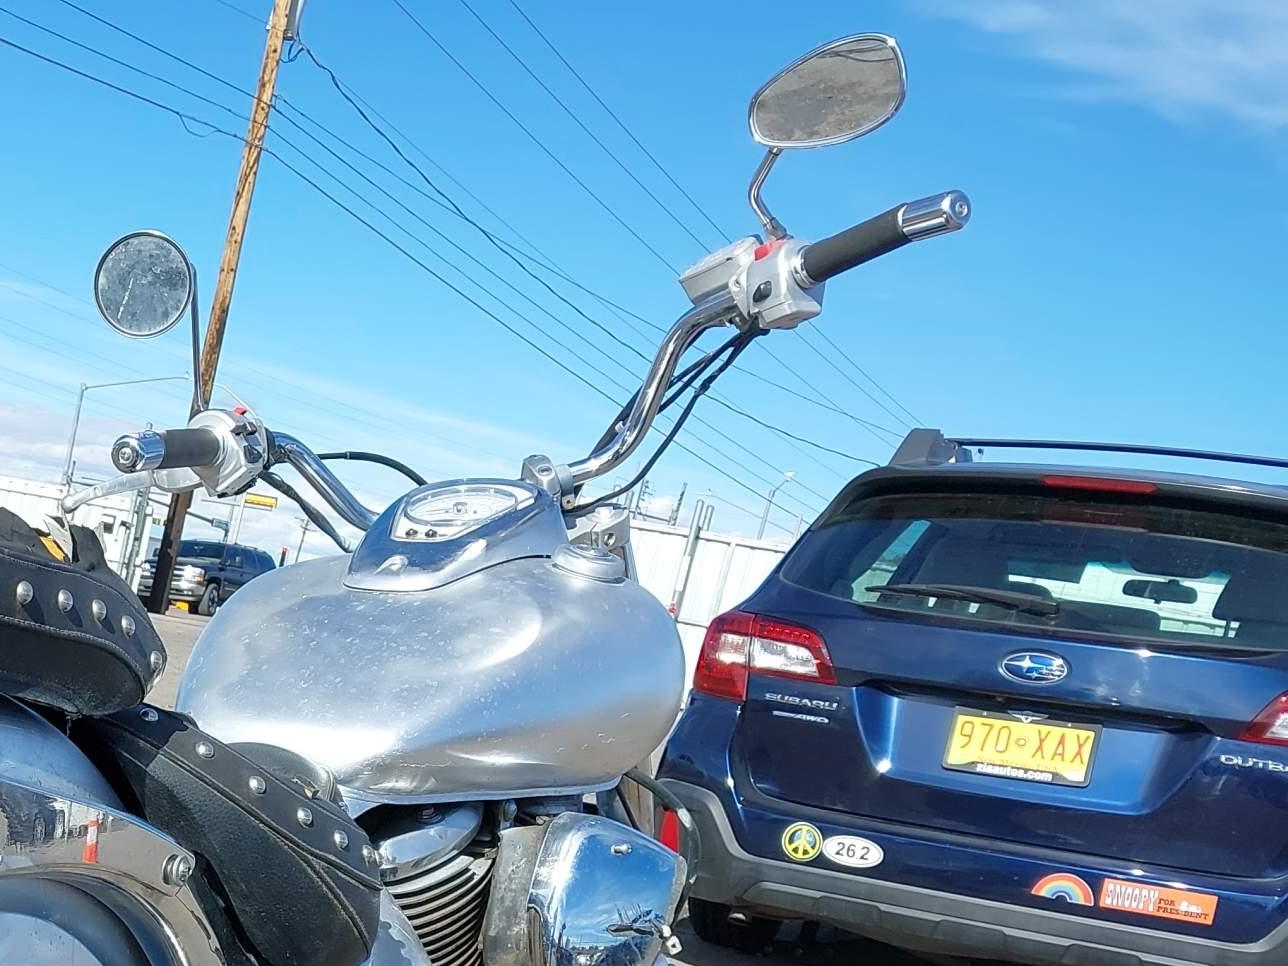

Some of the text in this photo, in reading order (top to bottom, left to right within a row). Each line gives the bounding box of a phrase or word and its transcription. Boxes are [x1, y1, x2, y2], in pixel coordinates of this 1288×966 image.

[764, 692, 838, 710] SUBARU
[959, 720, 1012, 754] 970
[1031, 728, 1092, 765] XAX
[1104, 882, 1160, 912] SNOOPY
[1157, 897, 1177, 907] FOR
[1156, 905, 1210, 920] PRESIDENT
